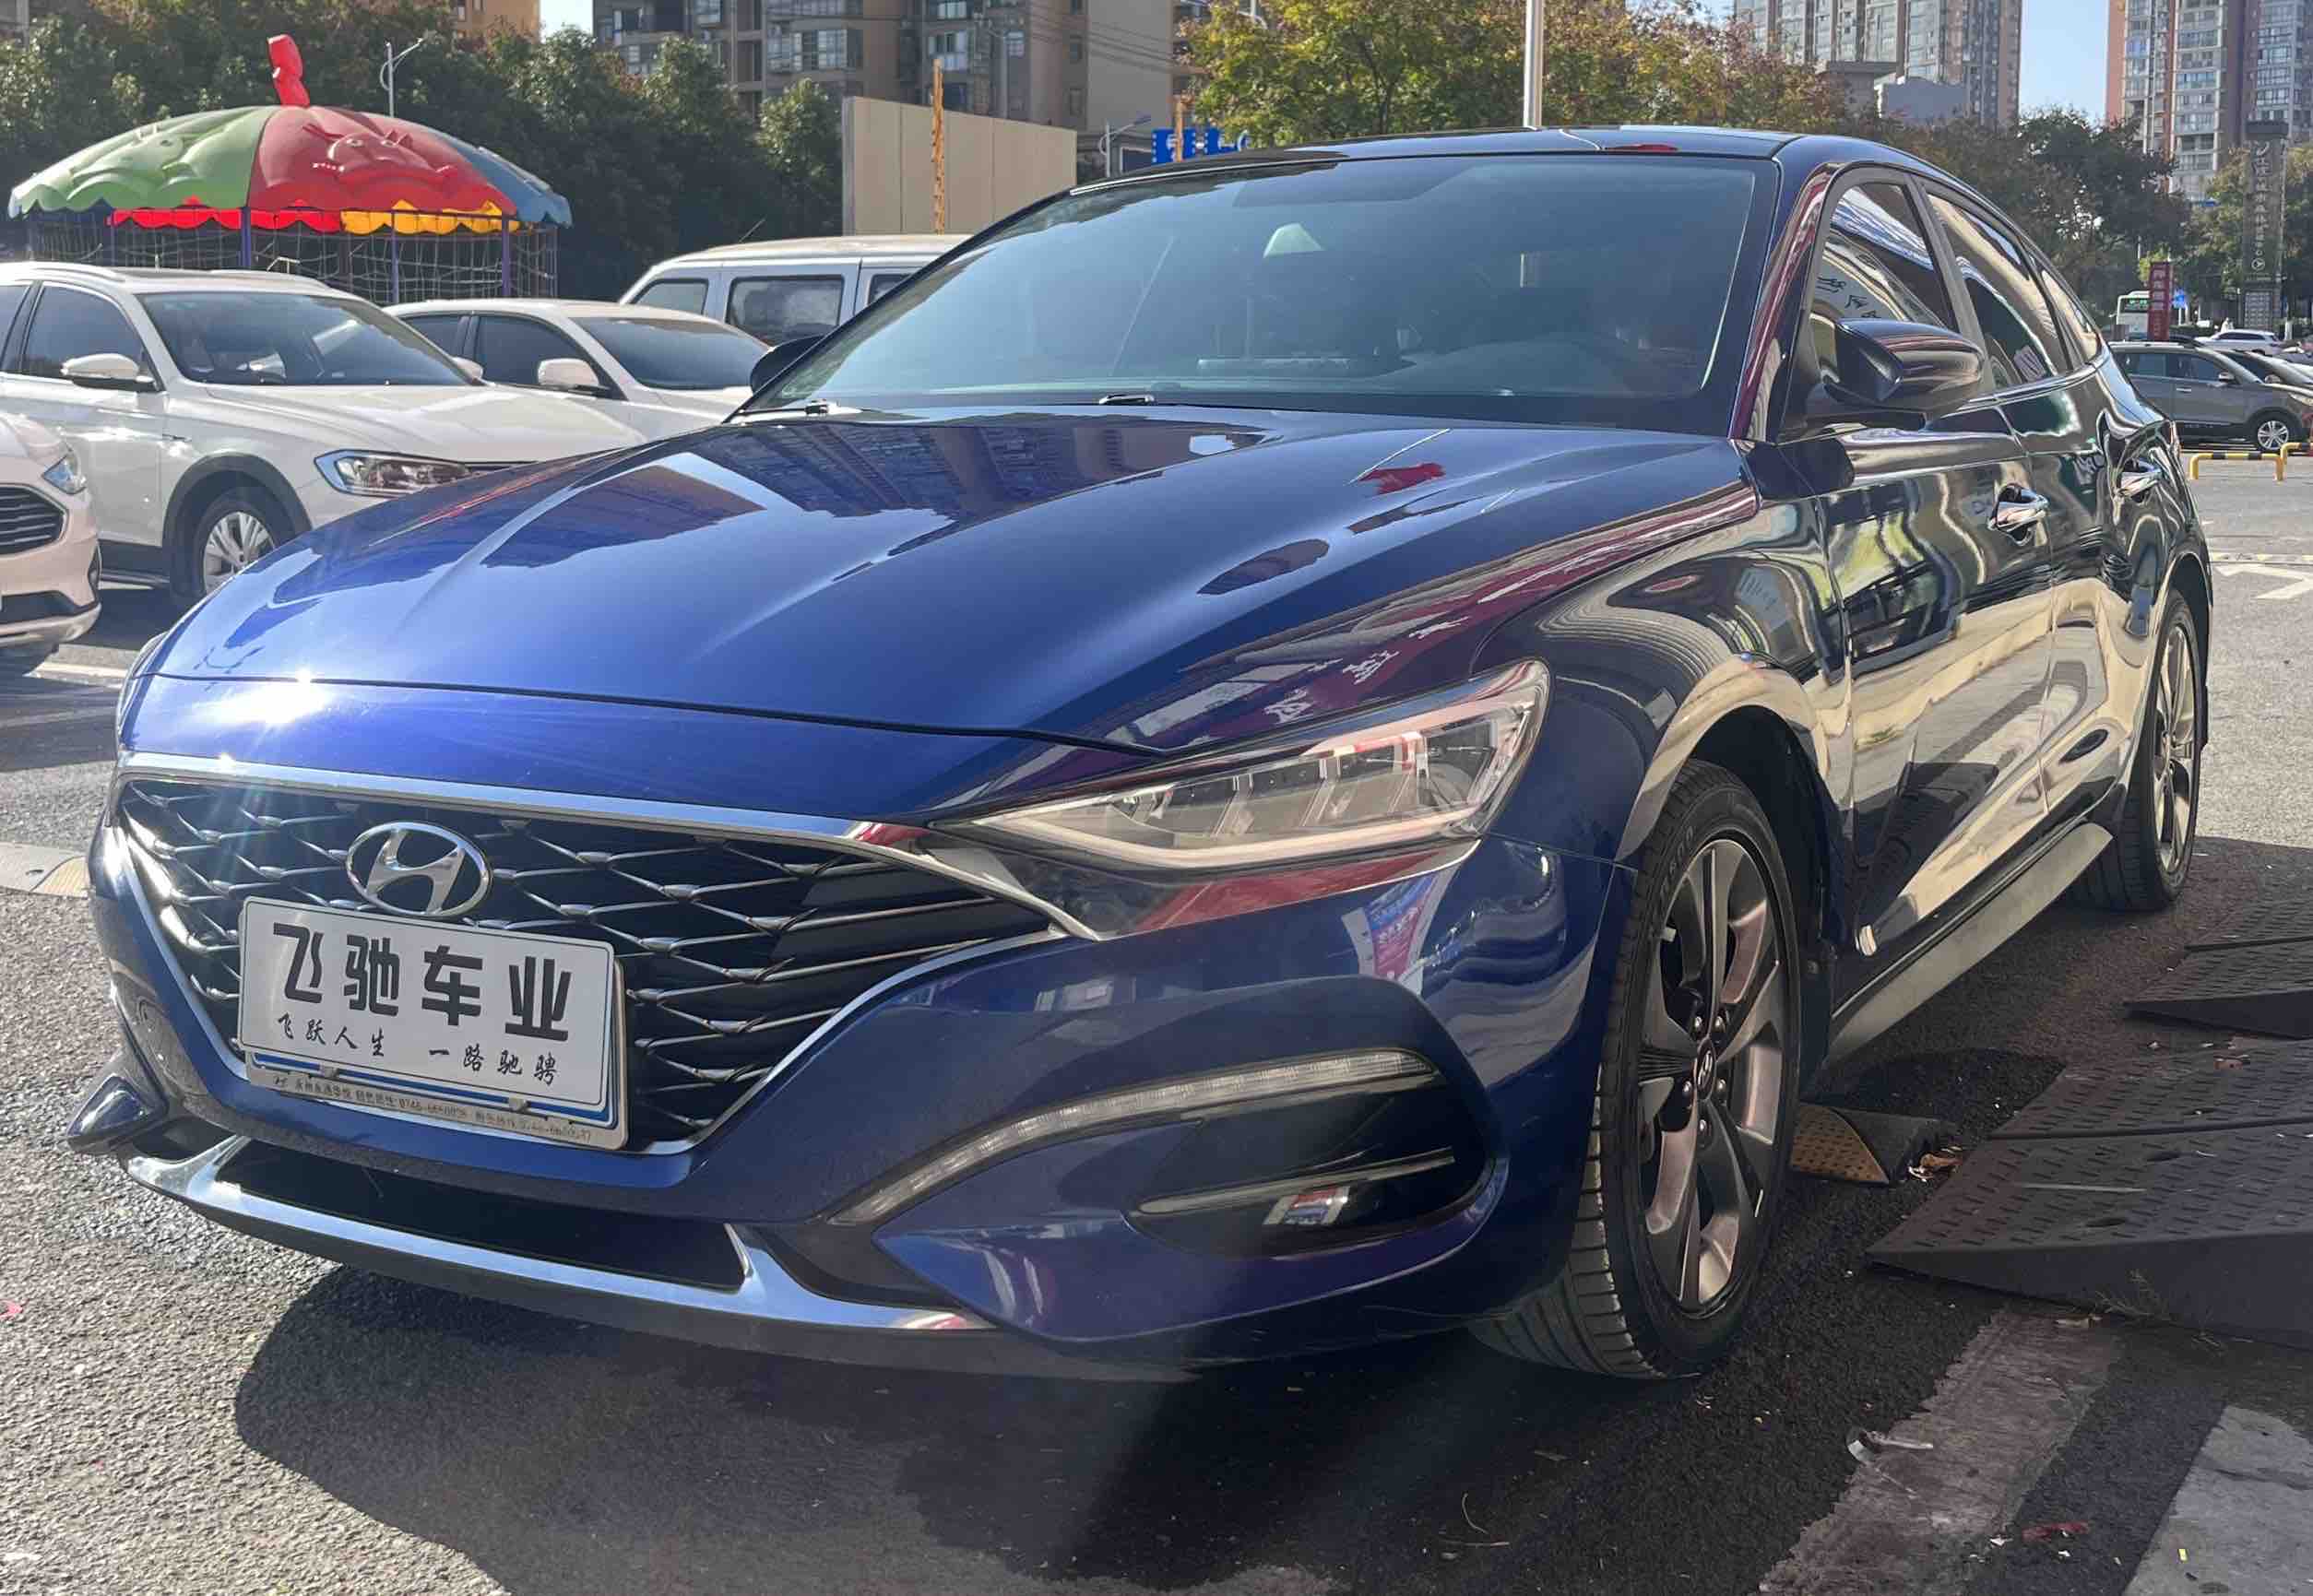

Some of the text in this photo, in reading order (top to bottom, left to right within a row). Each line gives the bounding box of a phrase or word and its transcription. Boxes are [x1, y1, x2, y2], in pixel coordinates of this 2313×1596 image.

[273, 923, 571, 1042] 飞驰车业
[278, 1012, 557, 1086] 飞跃人生 一路驰骋
